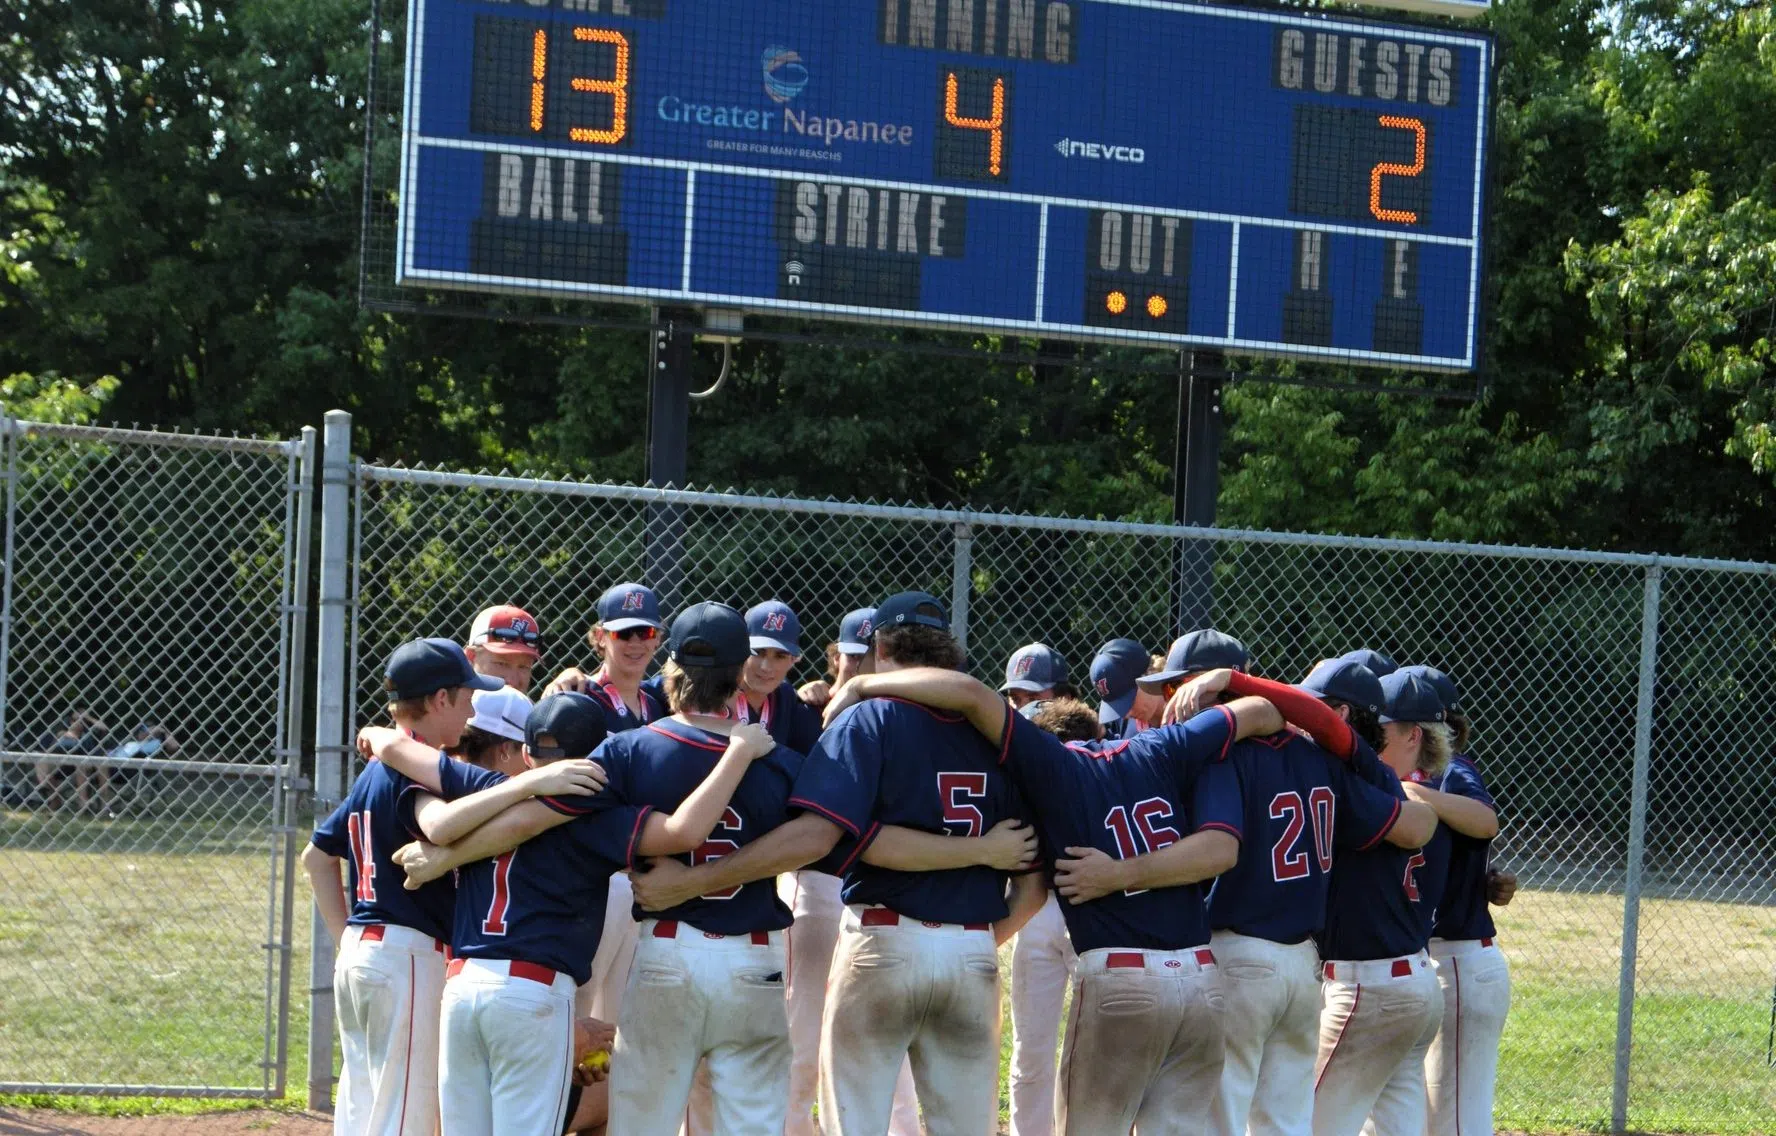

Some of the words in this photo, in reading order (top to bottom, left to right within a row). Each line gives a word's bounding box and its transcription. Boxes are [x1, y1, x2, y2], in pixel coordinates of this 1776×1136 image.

[884, 0, 1071, 63] INNING
[529, 27, 629, 145] 13
[1279, 29, 1453, 106] GUESTS
[657, 95, 774, 131] Greater
[783, 108, 913, 146] Napanee
[706, 139, 748, 153] GREATER
[749, 143, 769, 154] FOR
[770, 145, 798, 157] MANY
[945, 72, 1004, 176] 4
[1070, 140, 1145, 163] NEVCO
[498, 153, 604, 224] BALL
[1370, 115, 1426, 224] 2
[795, 181, 947, 256] STRIKE
[1100, 211, 1180, 276] OUT
[1301, 230, 1322, 291] H
[1393, 239, 1409, 299] E
[937, 772, 987, 837] 5
[1269, 786, 1336, 882] 20
